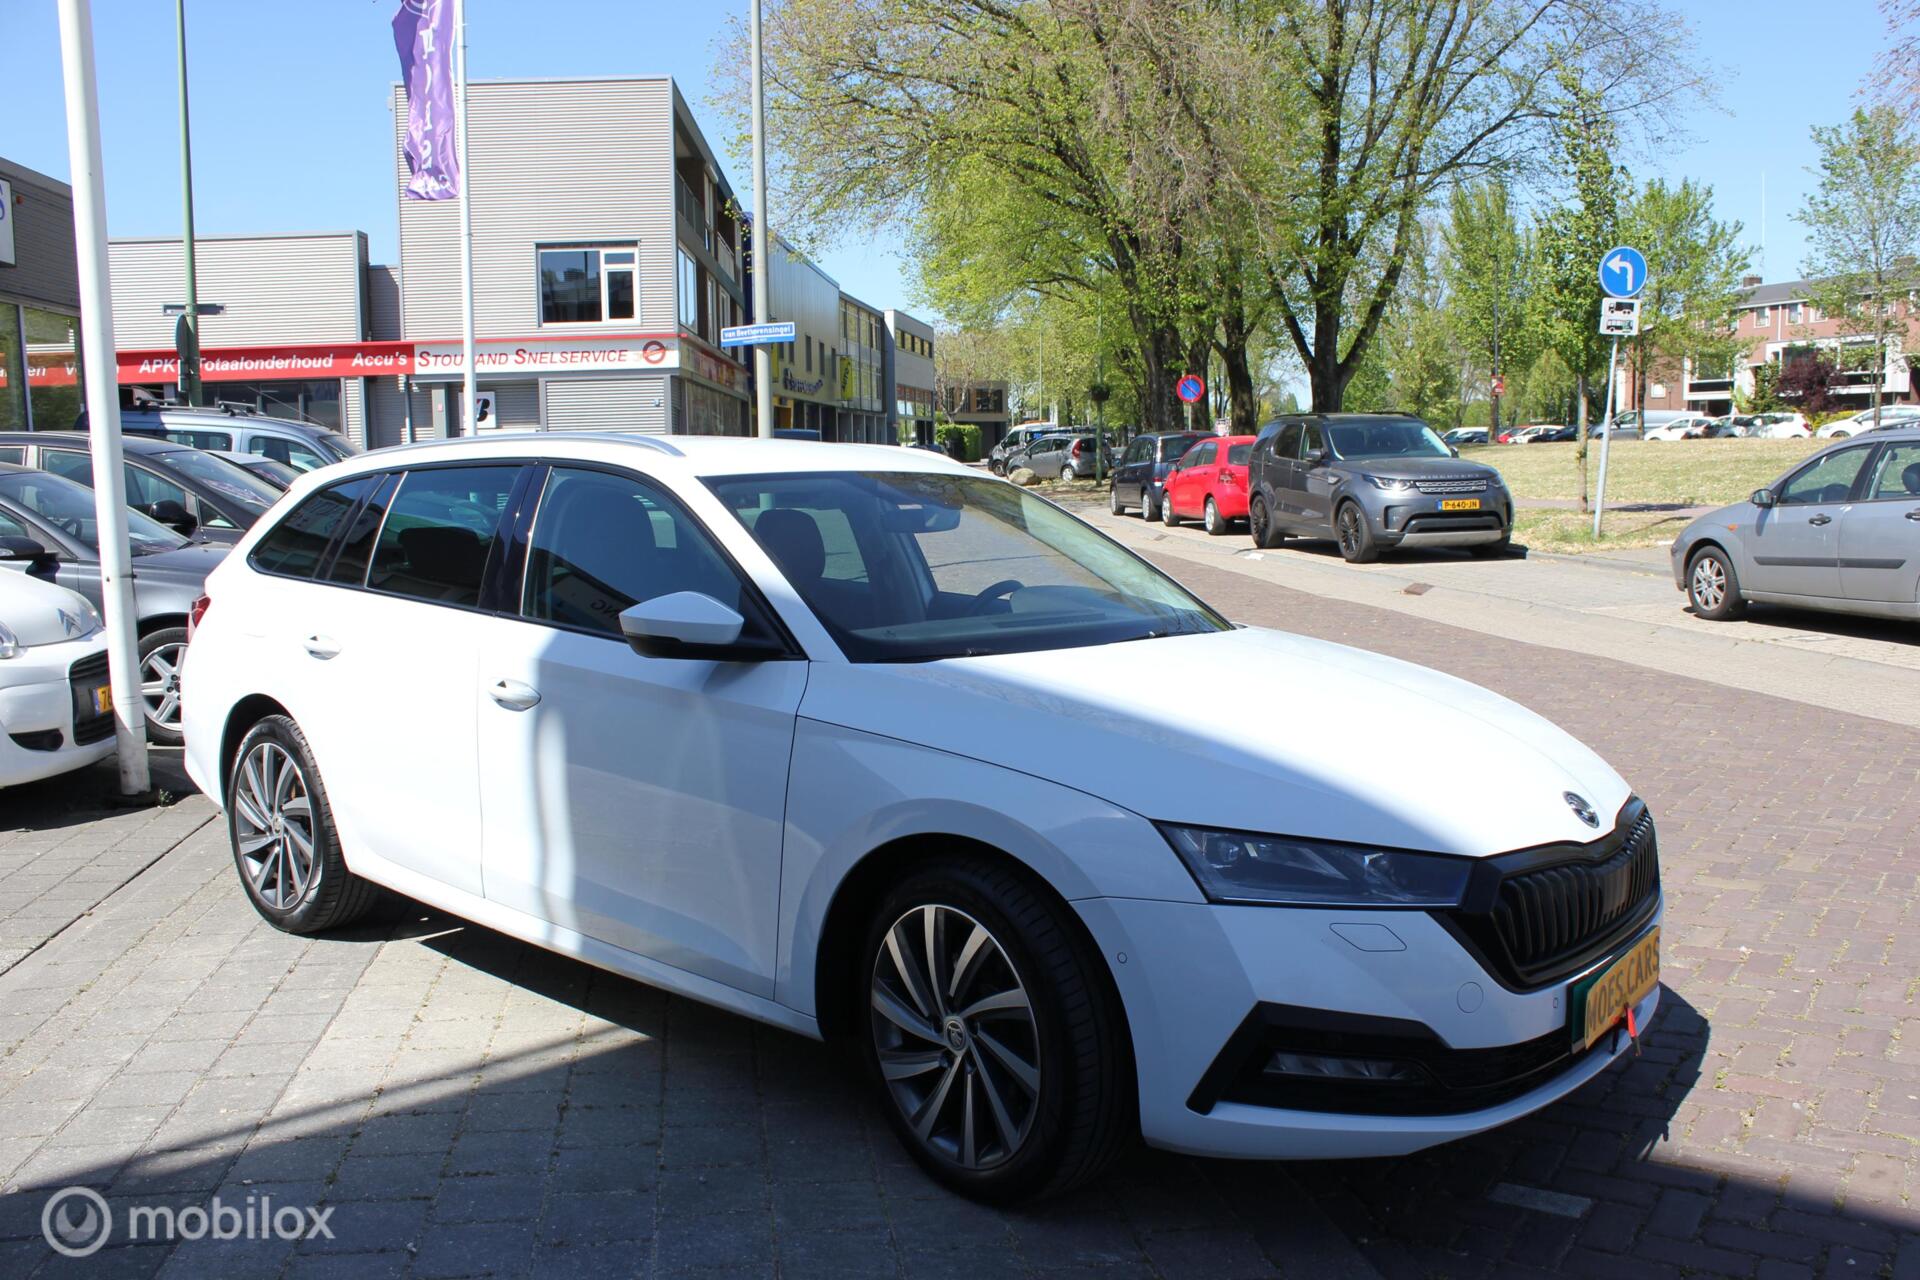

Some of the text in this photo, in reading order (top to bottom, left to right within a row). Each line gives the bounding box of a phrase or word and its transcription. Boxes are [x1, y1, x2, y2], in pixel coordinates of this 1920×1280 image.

[724, 330, 736, 338] van
[139, 357, 176, 374] APK
[351, 350, 408, 368] Accu's
[418, 350, 509, 367] STOUAND
[514, 347, 629, 365] SNELSERVICE
[1627, 935, 1660, 994] CARS
